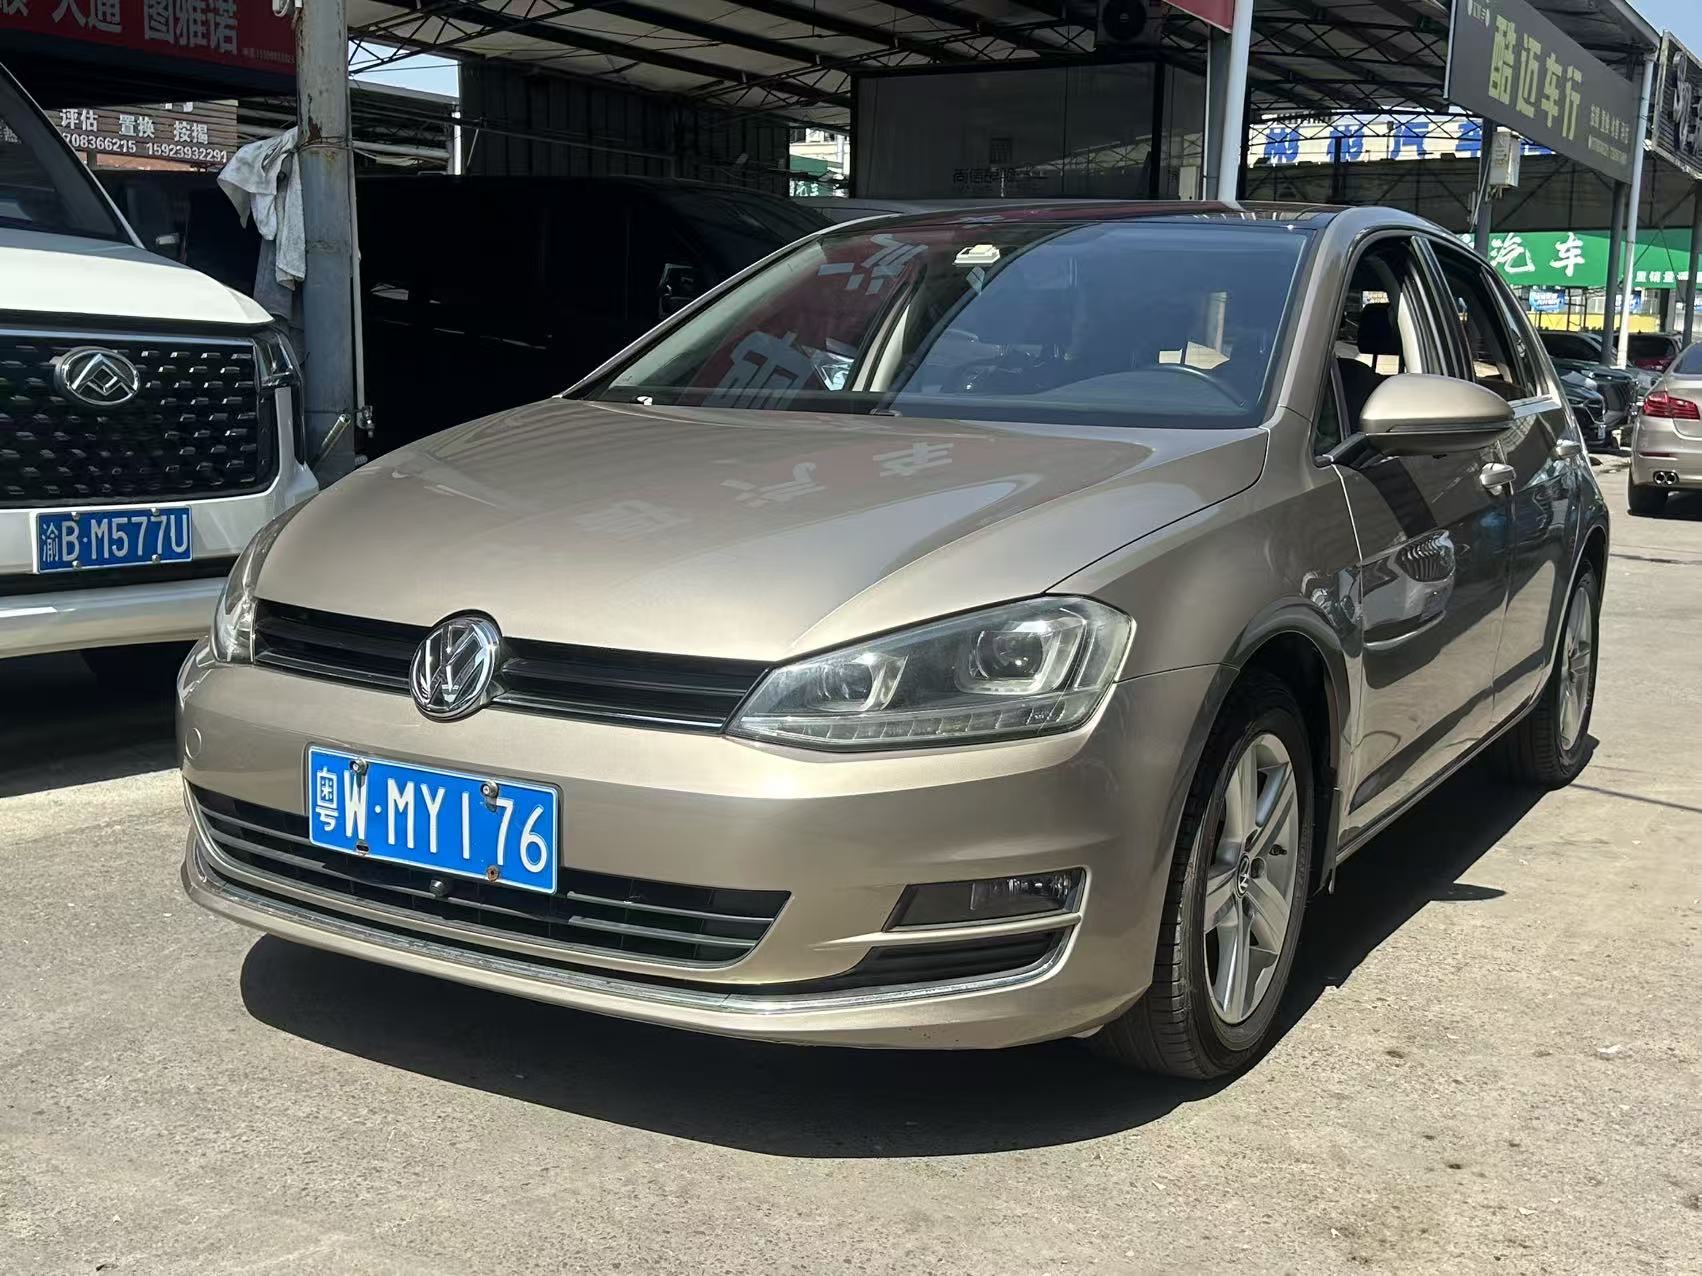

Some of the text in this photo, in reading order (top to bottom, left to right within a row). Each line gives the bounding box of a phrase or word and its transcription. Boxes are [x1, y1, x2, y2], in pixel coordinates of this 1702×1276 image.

[1488, 14, 1584, 141] 酷迈车行
[59, 107, 209, 145] 评估 置换 按揭
[42, 513, 189, 563] 渝B·M577U
[315, 765, 549, 874] 粤W·MY176
